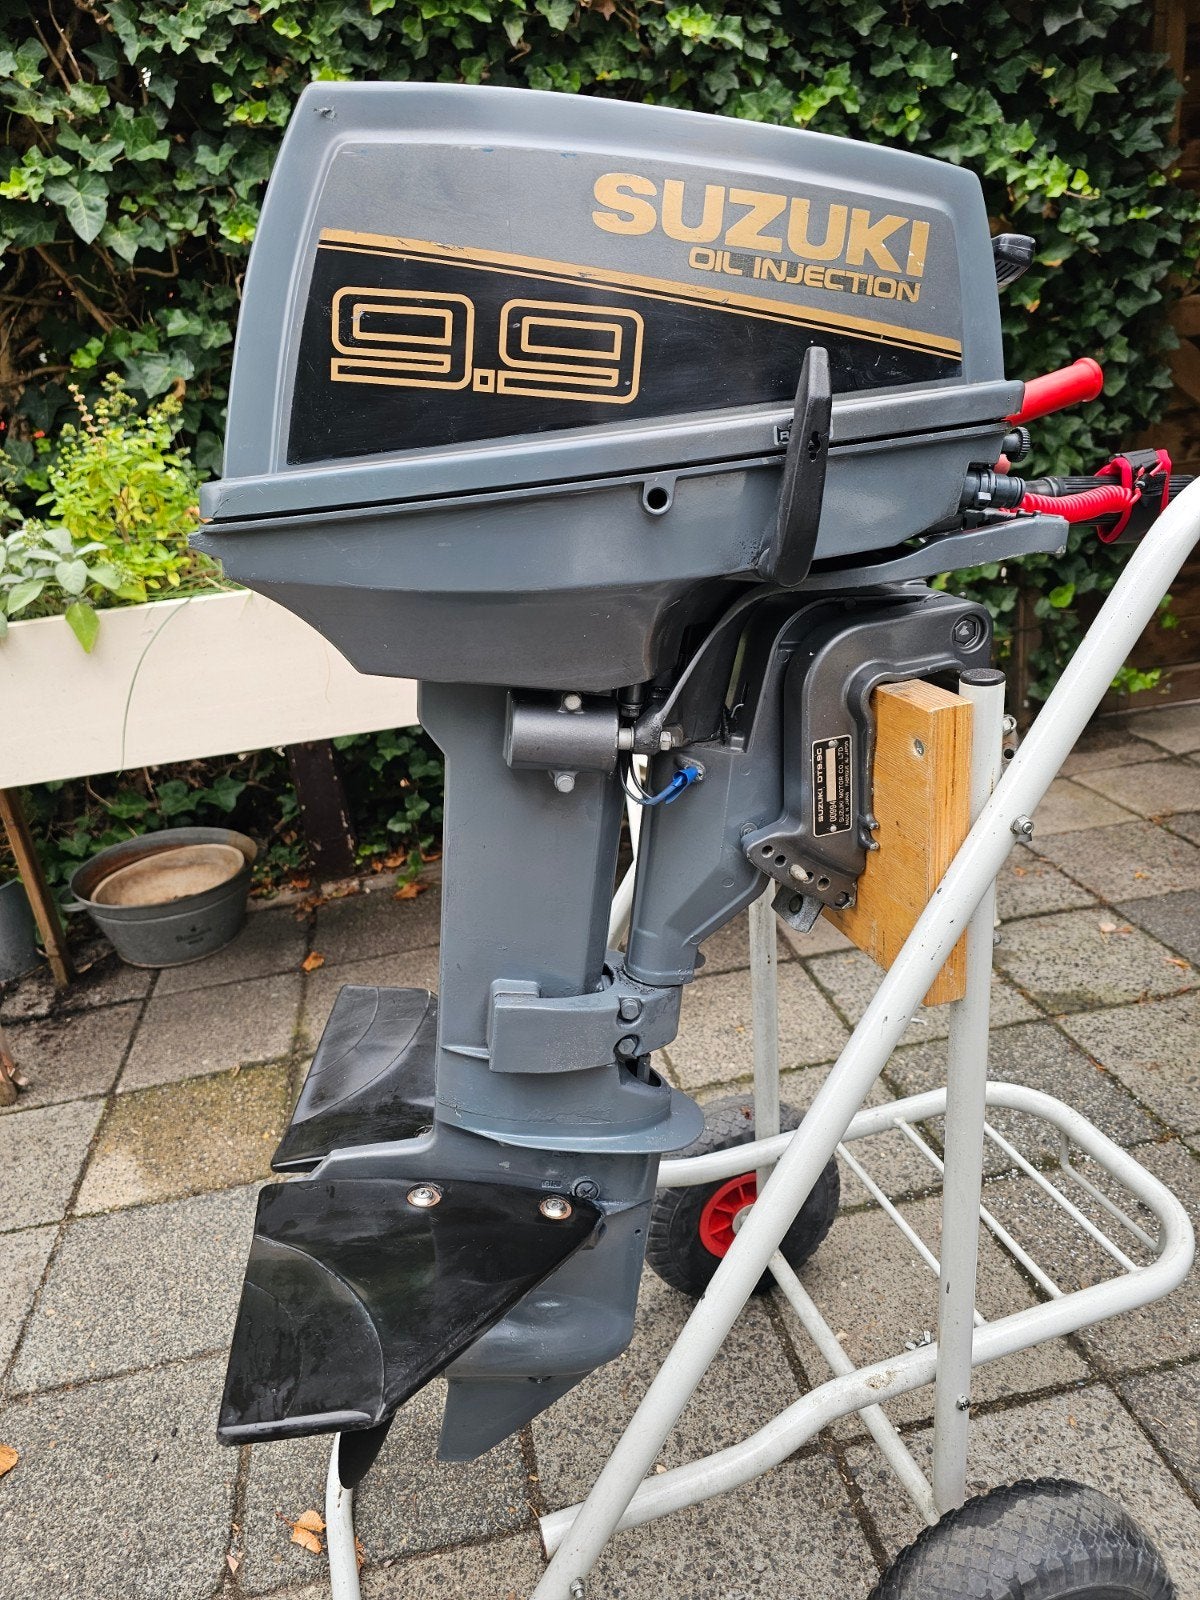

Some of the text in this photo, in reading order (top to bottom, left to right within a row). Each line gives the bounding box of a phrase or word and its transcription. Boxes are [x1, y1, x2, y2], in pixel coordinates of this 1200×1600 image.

[592, 172, 930, 278] SUZUKI
[688, 246, 922, 303] OIL INJECTION
[330, 286, 646, 405] 9.9
